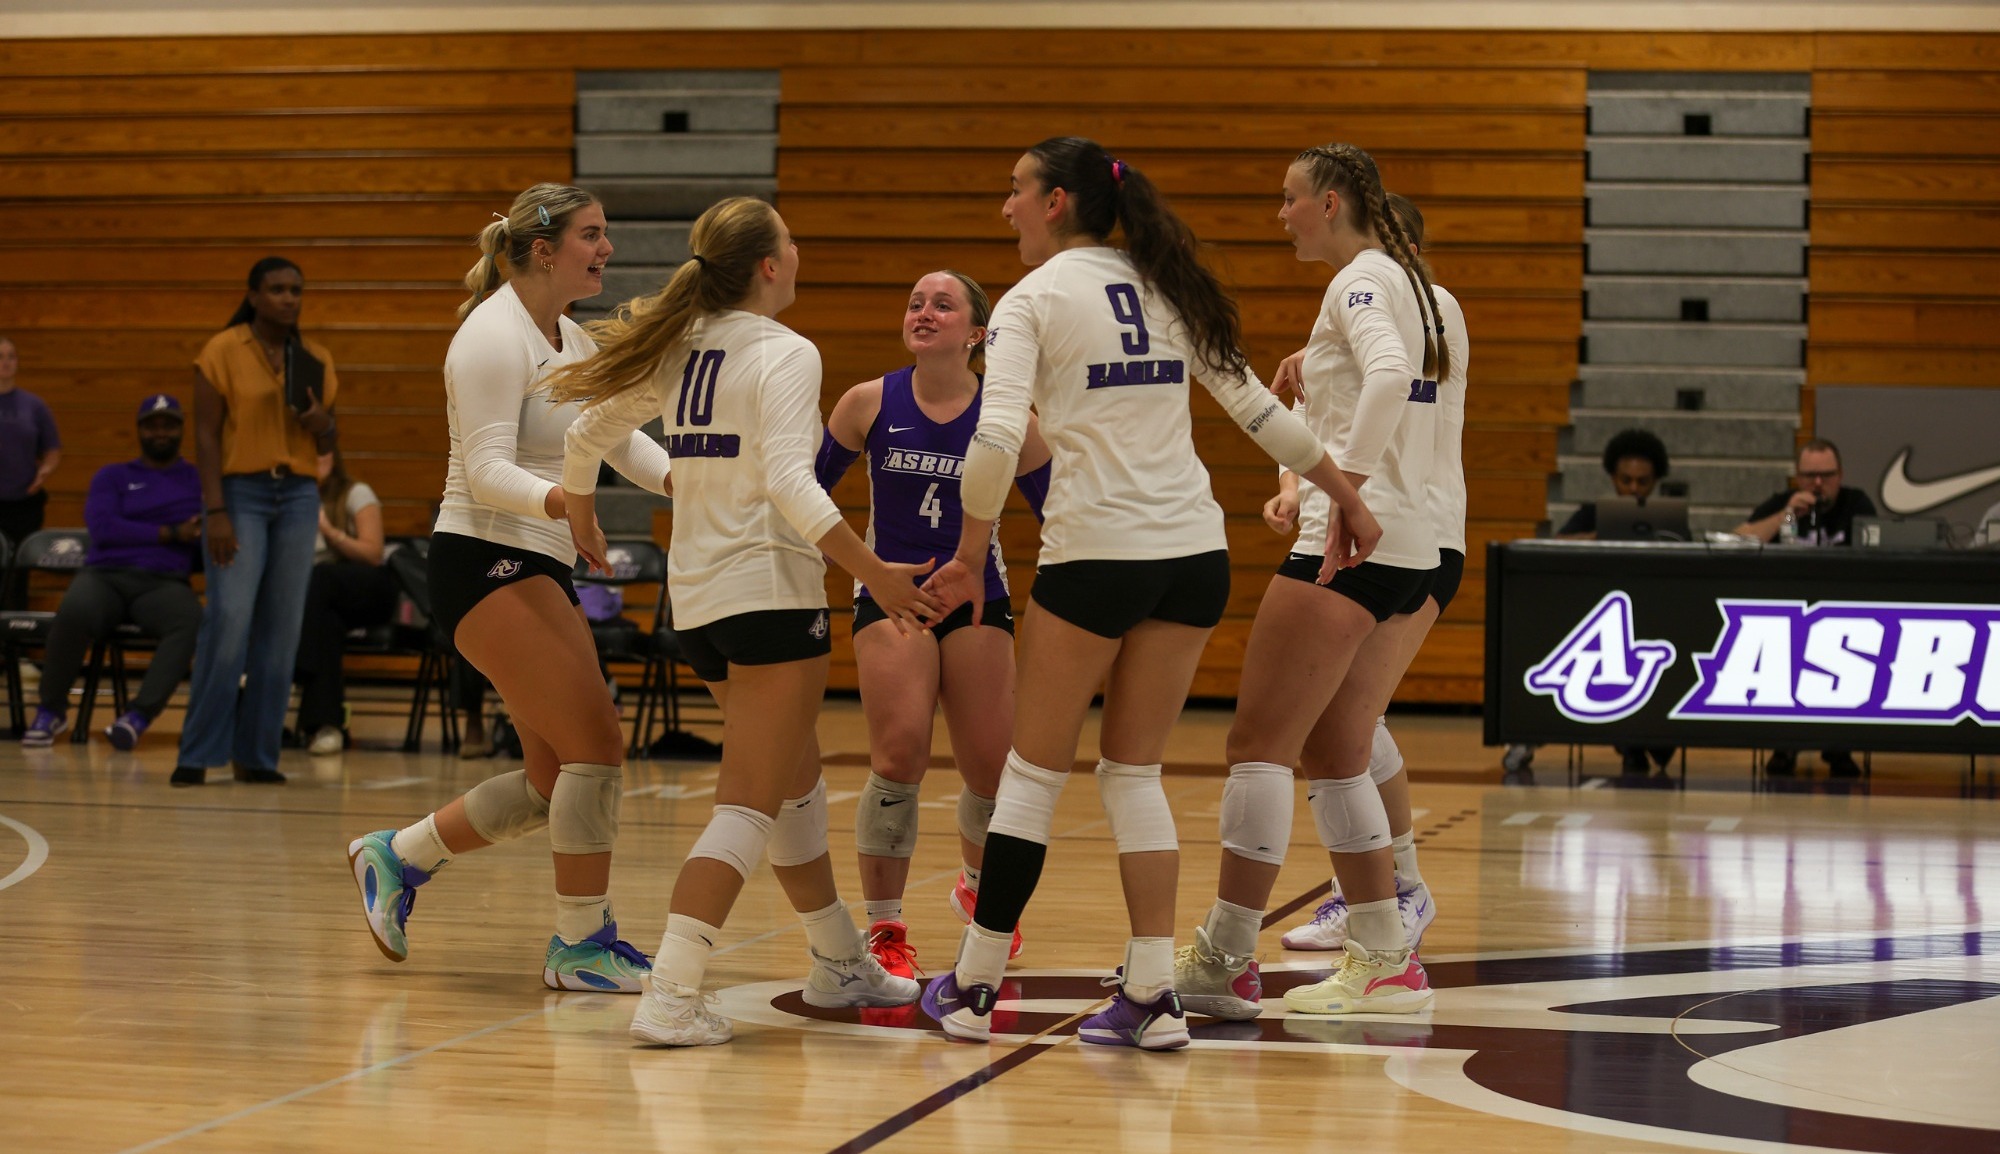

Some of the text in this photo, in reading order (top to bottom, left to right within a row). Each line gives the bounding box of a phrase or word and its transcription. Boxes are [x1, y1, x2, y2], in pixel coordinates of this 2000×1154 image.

[1105, 283, 1150, 355] 9
[676, 349, 726, 427] 10
[1086, 359, 1184, 390] EAGLES
[919, 482, 942, 528] 4
[1524, 591, 1676, 722] AU
[1704, 615, 2000, 712] ASB
